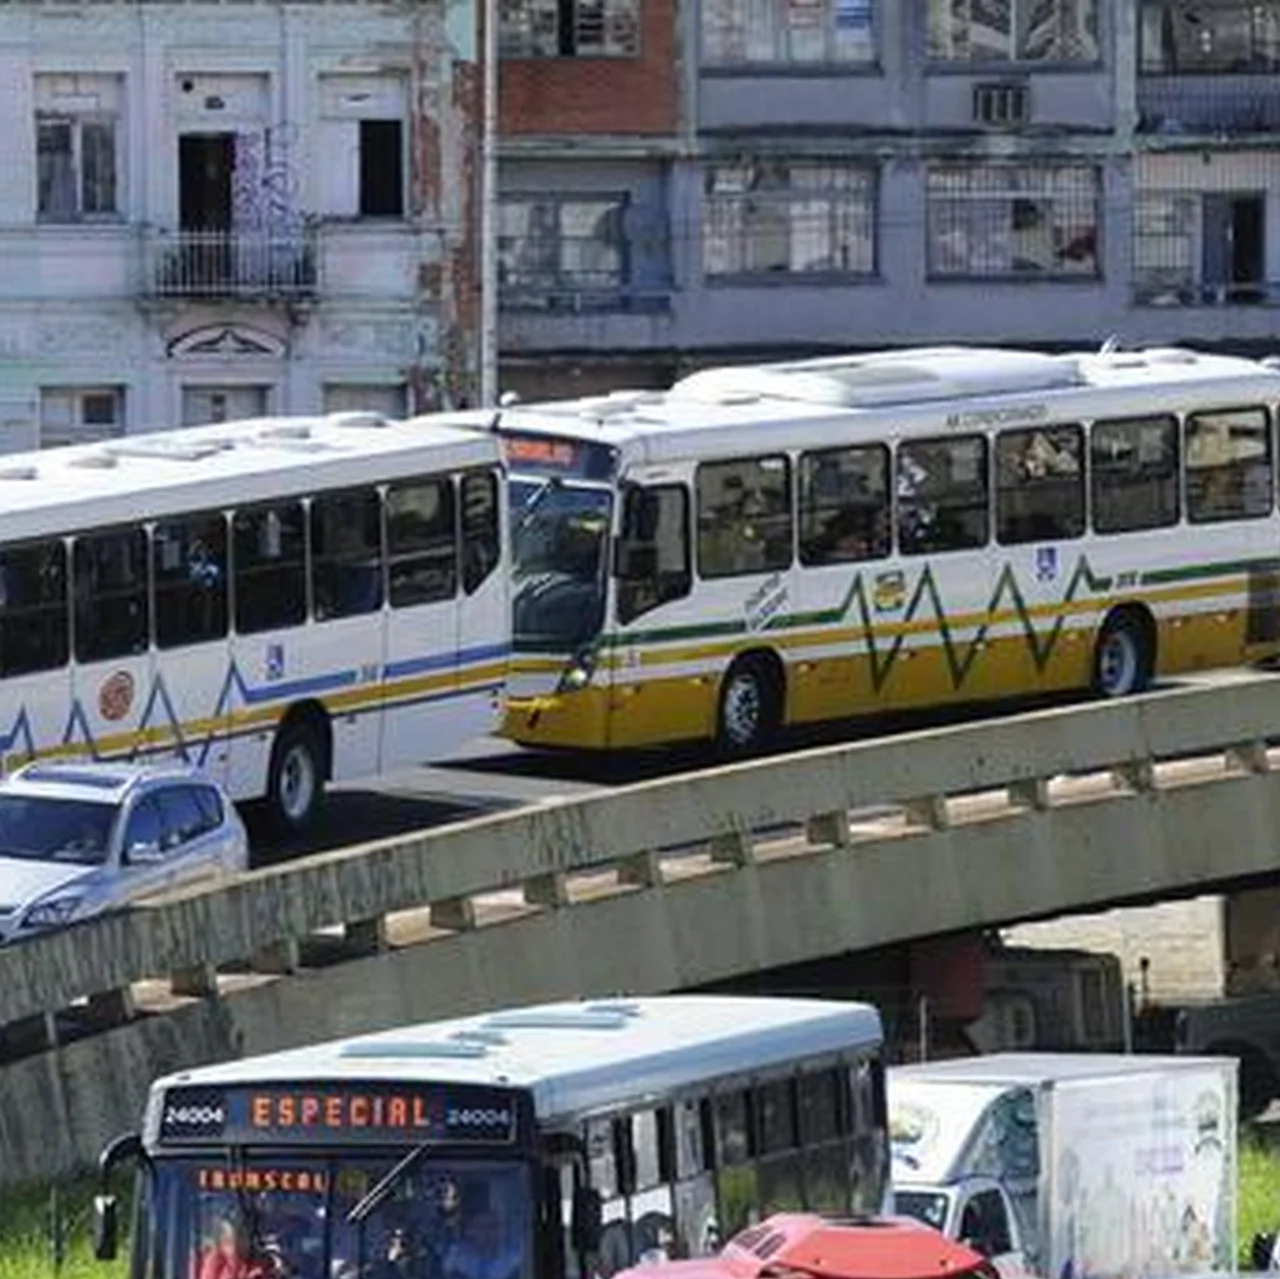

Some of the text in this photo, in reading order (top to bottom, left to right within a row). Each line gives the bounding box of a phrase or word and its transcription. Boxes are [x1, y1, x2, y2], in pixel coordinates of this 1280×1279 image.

[166, 1105, 224, 1123] 24004
[252, 1096, 430, 1127] ESPECIAL
[446, 1108, 510, 1126] 24004
